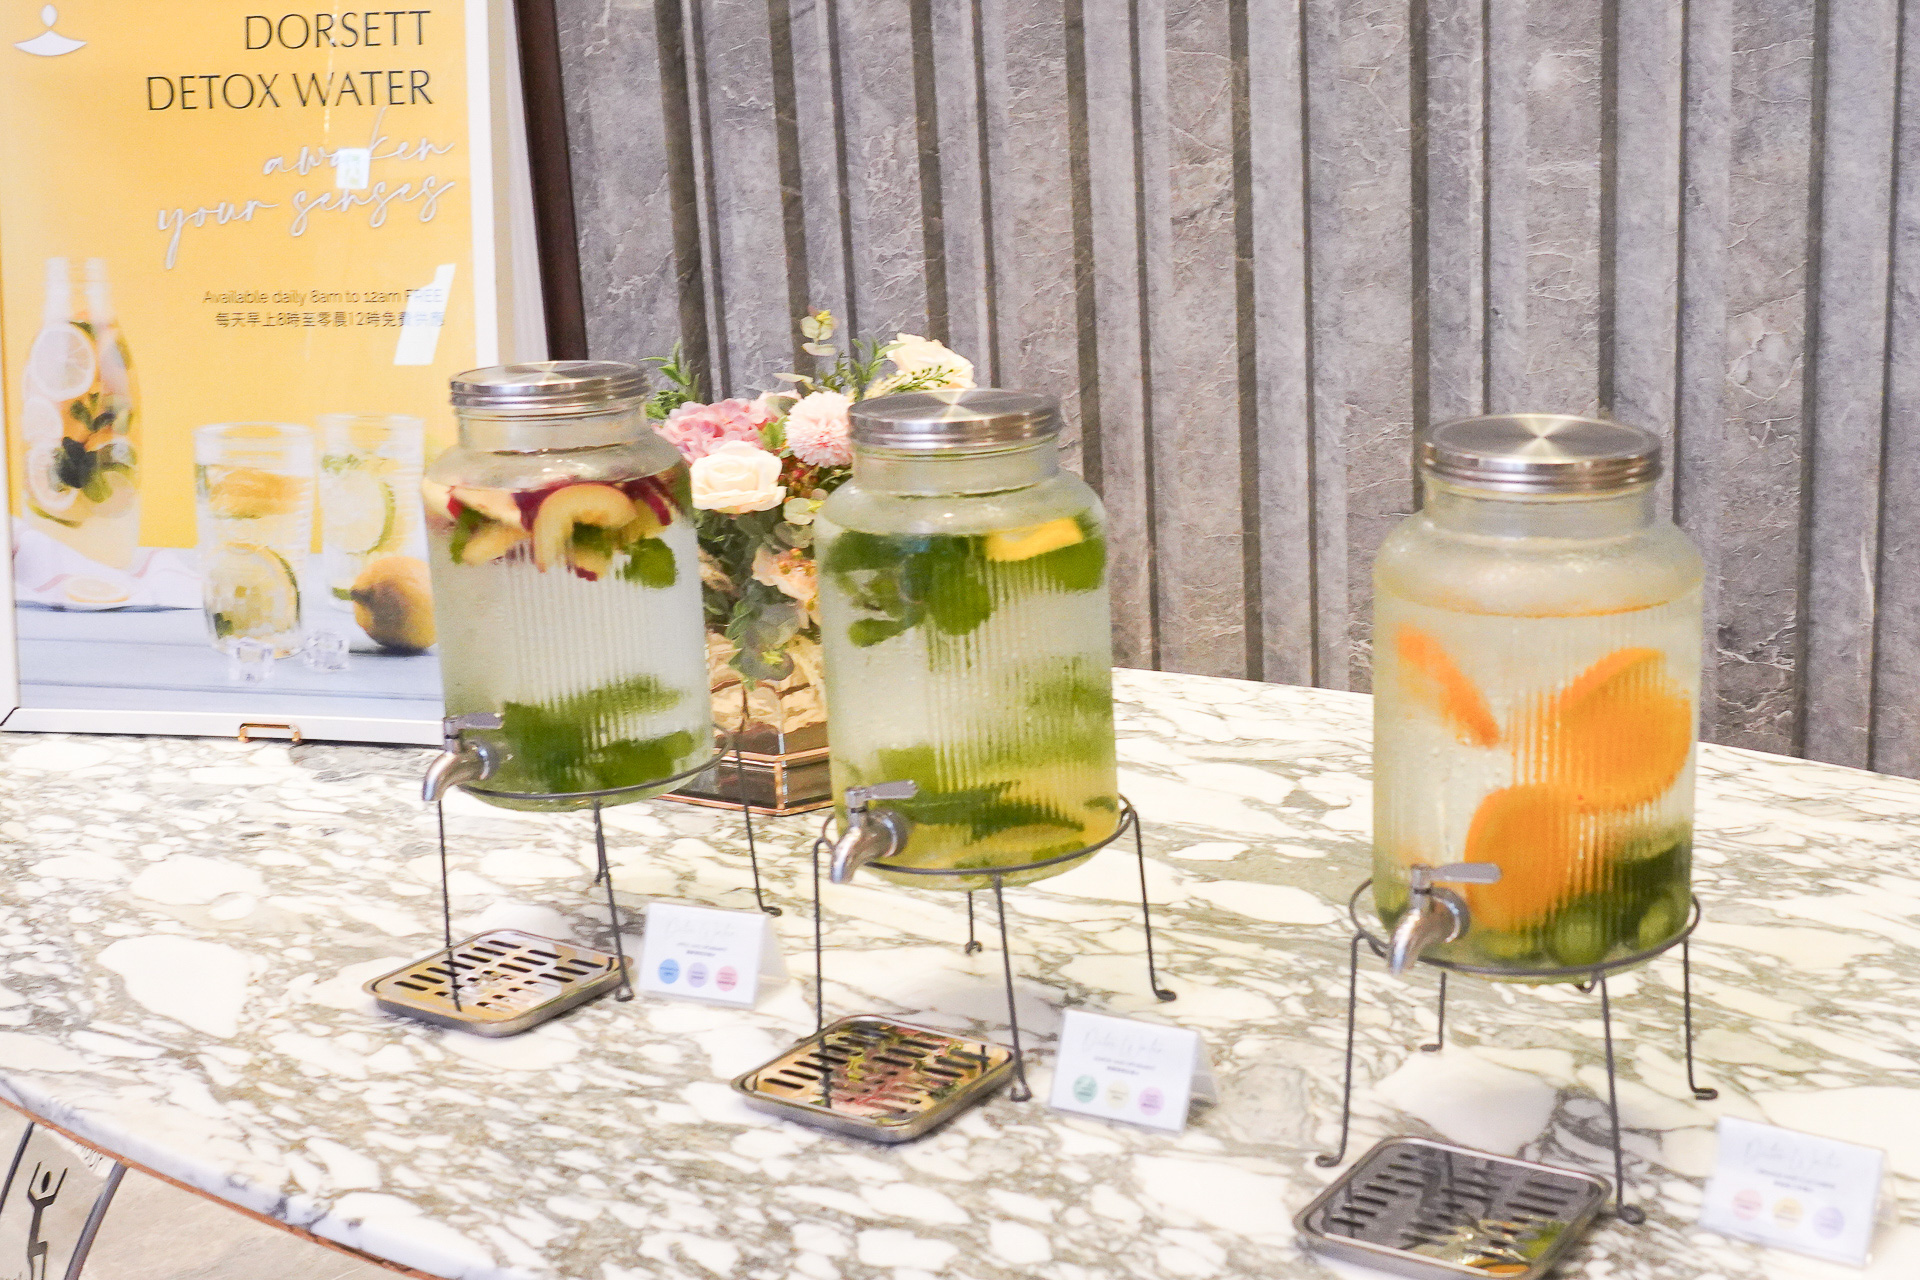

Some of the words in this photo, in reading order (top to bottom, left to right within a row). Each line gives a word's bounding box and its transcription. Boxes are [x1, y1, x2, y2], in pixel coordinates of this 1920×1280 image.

[245, 10, 432, 50] DORSETT
[146, 73, 280, 111] DETOX
[291, 69, 434, 107] WATER
[157, 200, 280, 270] your
[290, 175, 456, 237] senses
[202, 289, 268, 304] Available
[272, 289, 306, 307] daily
[310, 289, 342, 304] 8am
[344, 289, 360, 303] to
[363, 291, 402, 303] 12am
